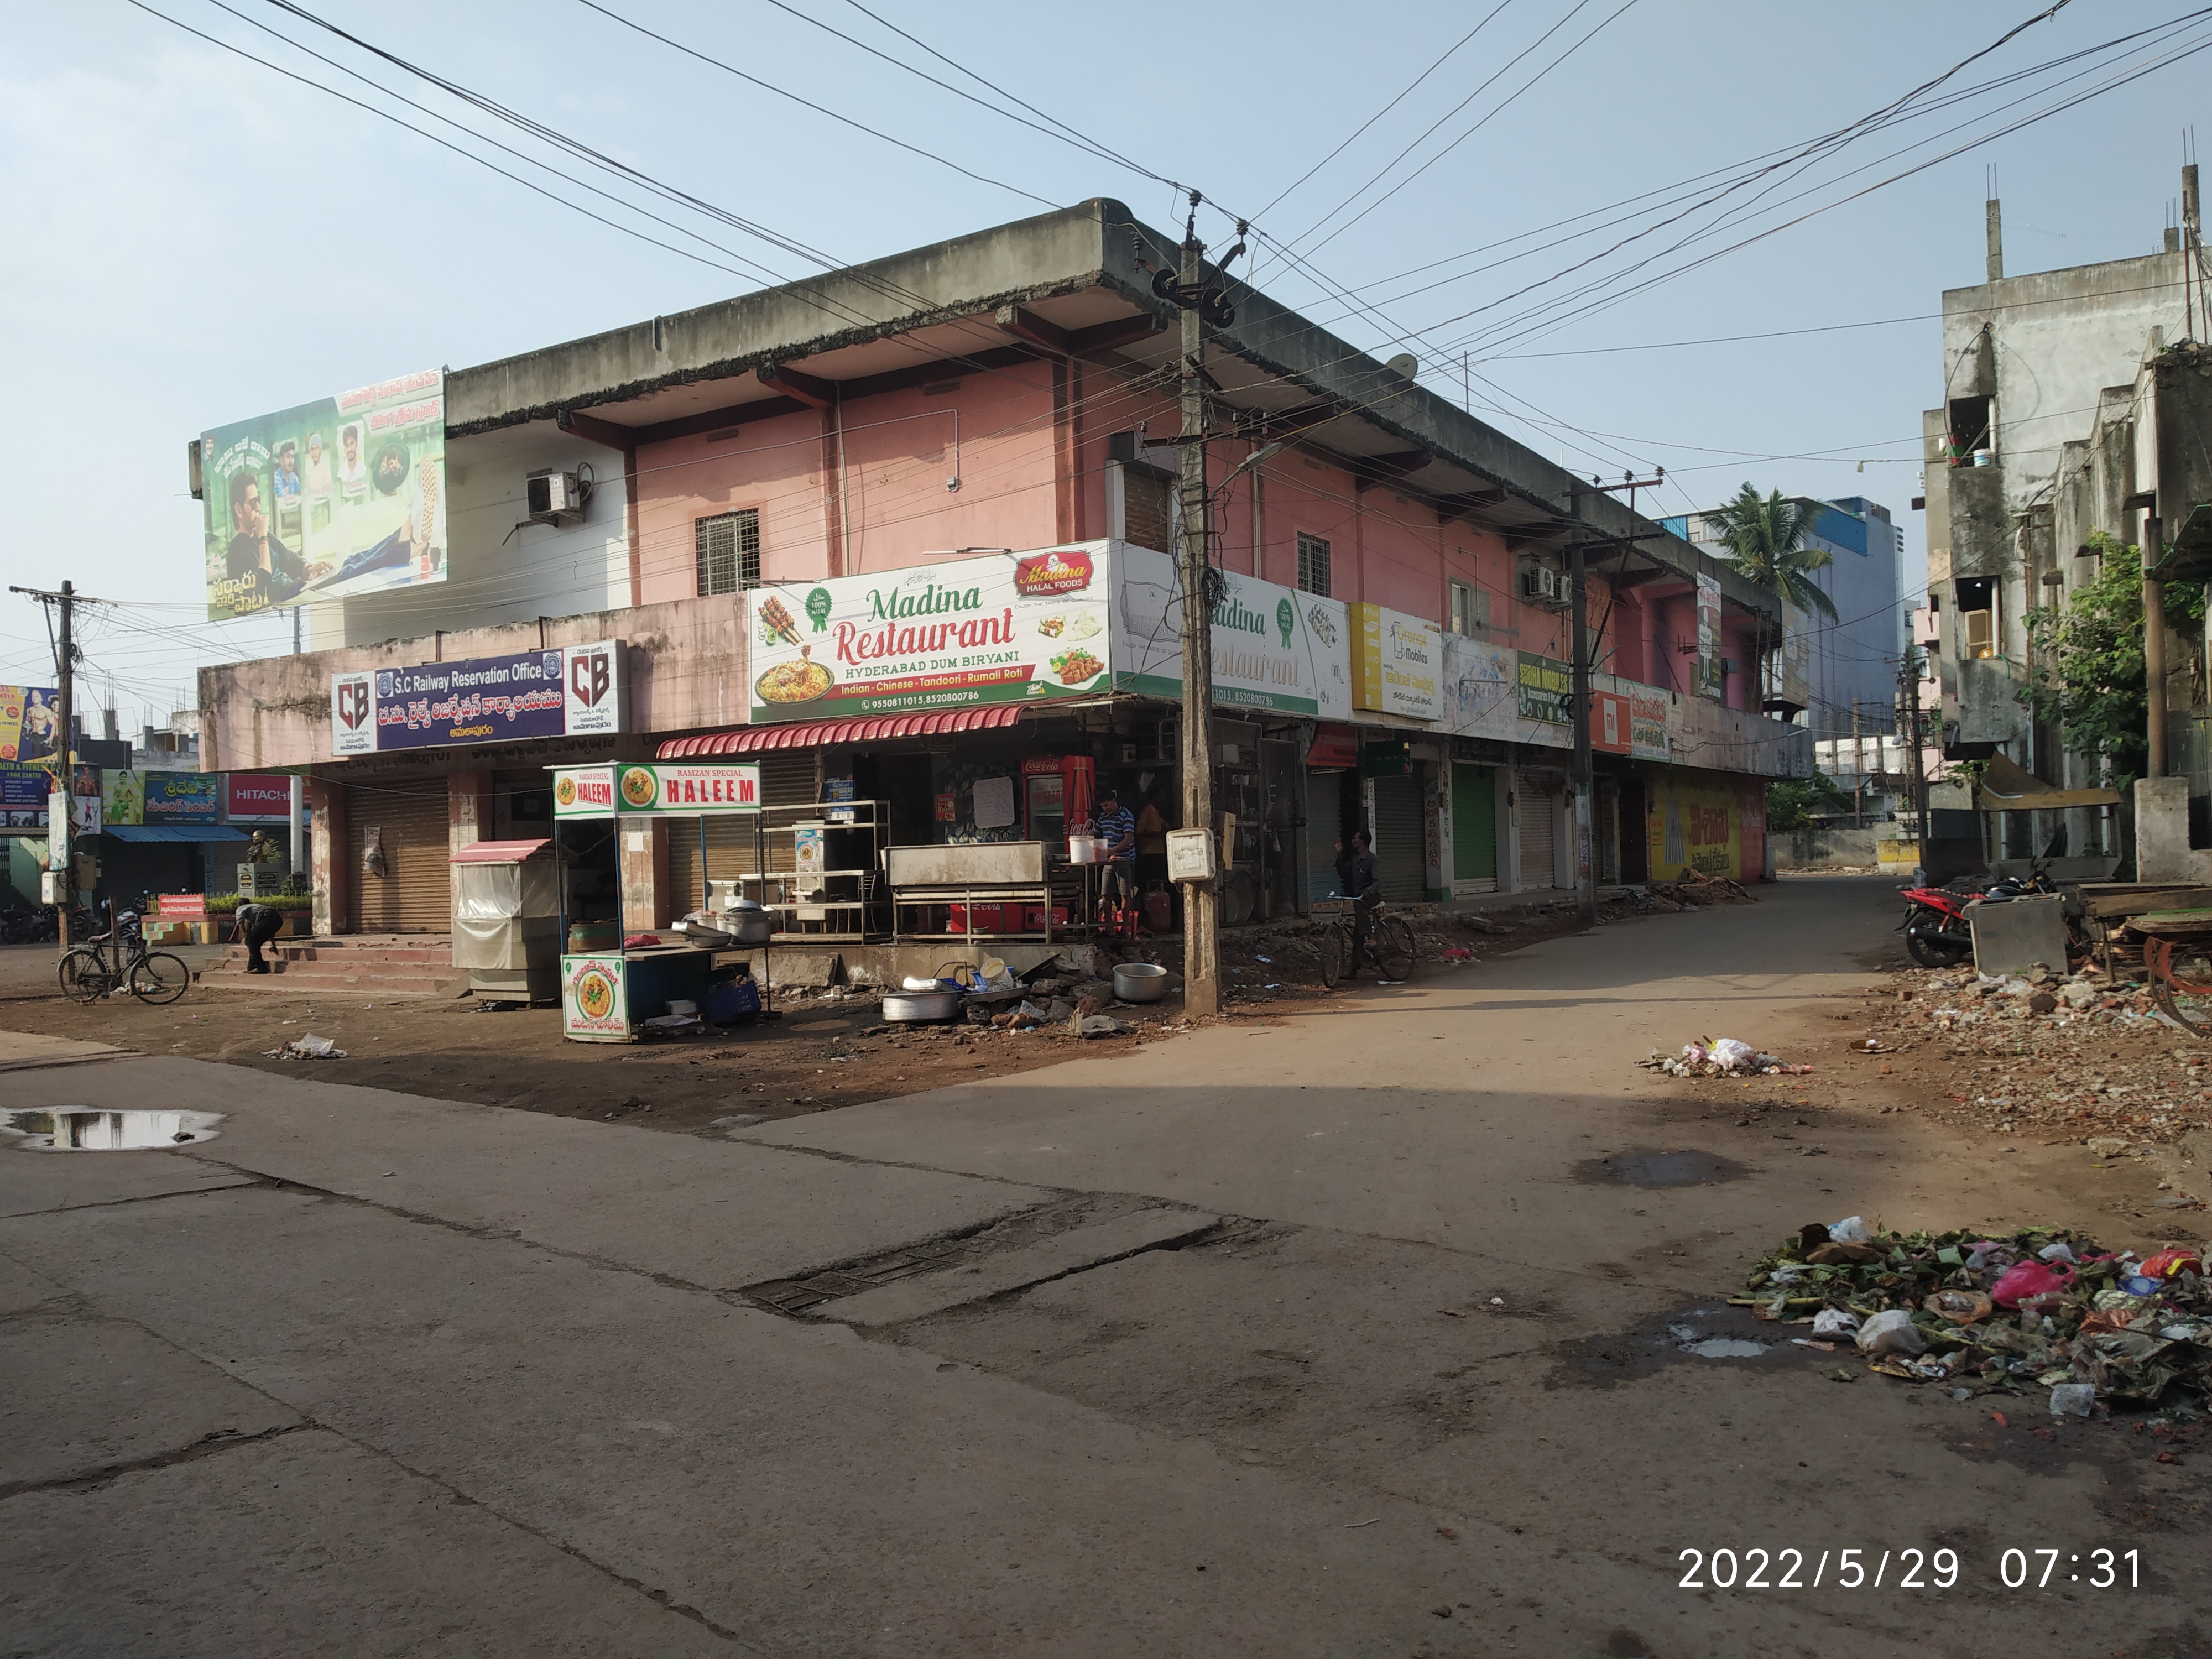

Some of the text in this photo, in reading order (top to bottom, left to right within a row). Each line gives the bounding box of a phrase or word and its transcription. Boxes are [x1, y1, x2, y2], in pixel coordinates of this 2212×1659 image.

[1019, 564, 1087, 584] Madina
[1027, 579, 1083, 592] HALAL FOODS
[866, 584, 983, 623] Madina
[1211, 597, 1266, 636] adina
[833, 607, 1016, 665] Restaurant
[1397, 624, 1427, 649] Orange
[846, 651, 1020, 679] HYDERABAD DUM BIRYANI
[1211, 643, 1300, 687] estaurant
[1406, 648, 1428, 664] Mobiles
[395, 662, 542, 695] S.C Railway Reservation Office
[842, 684, 870, 695] Indian
[876, 681, 913, 692] Chinese
[920, 674, 961, 687] Tandoori
[968, 670, 1001, 682] Rumali
[1004, 667, 1023, 679] Roti
[1519, 662, 1568, 694] SUDHA MOBILES
[872, 691, 979, 709] 9550811015,8520800786
[450, 724, 493, 738] అమలాపురం
[164, 779, 198, 797] శ్రీదేవి
[237, 789, 290, 801] HITACHI
[577, 782, 611, 805] HALEEM
[667, 779, 754, 803] HALEEM
